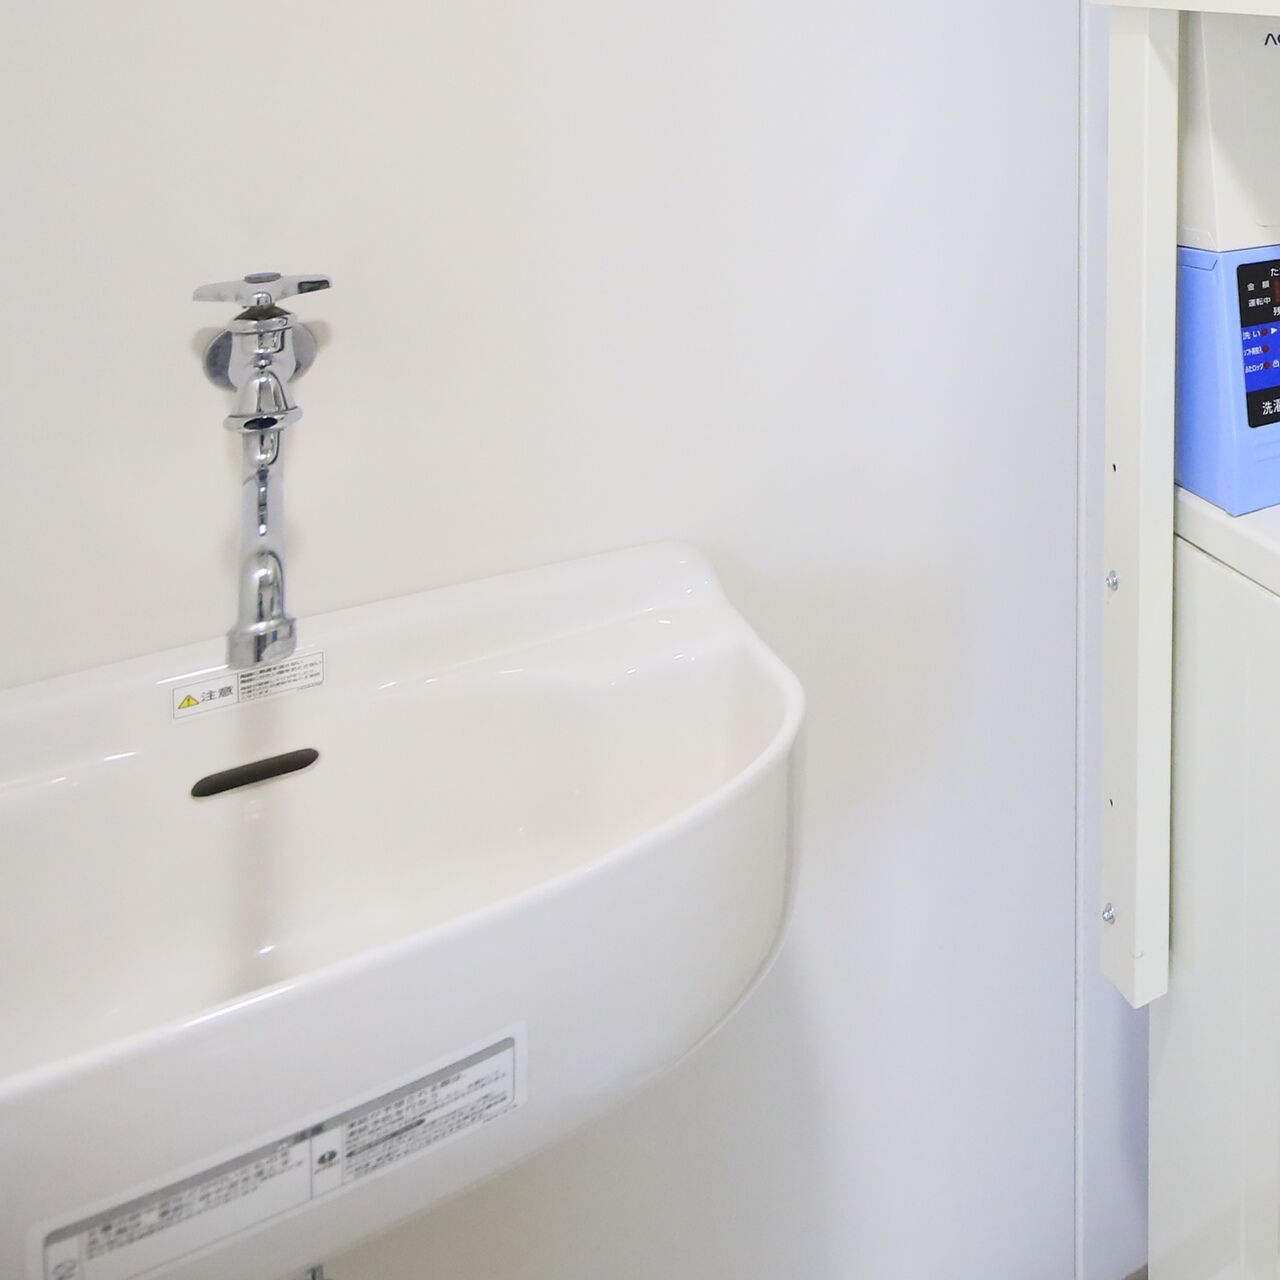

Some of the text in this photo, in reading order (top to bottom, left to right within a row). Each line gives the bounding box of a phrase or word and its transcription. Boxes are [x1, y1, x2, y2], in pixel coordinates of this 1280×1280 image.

[1247, 280, 1270, 291] 金額
[1248, 297, 1271, 307] 運転中
[1242, 330, 1260, 340] 洗い
[201, 686, 233, 702] 注意
